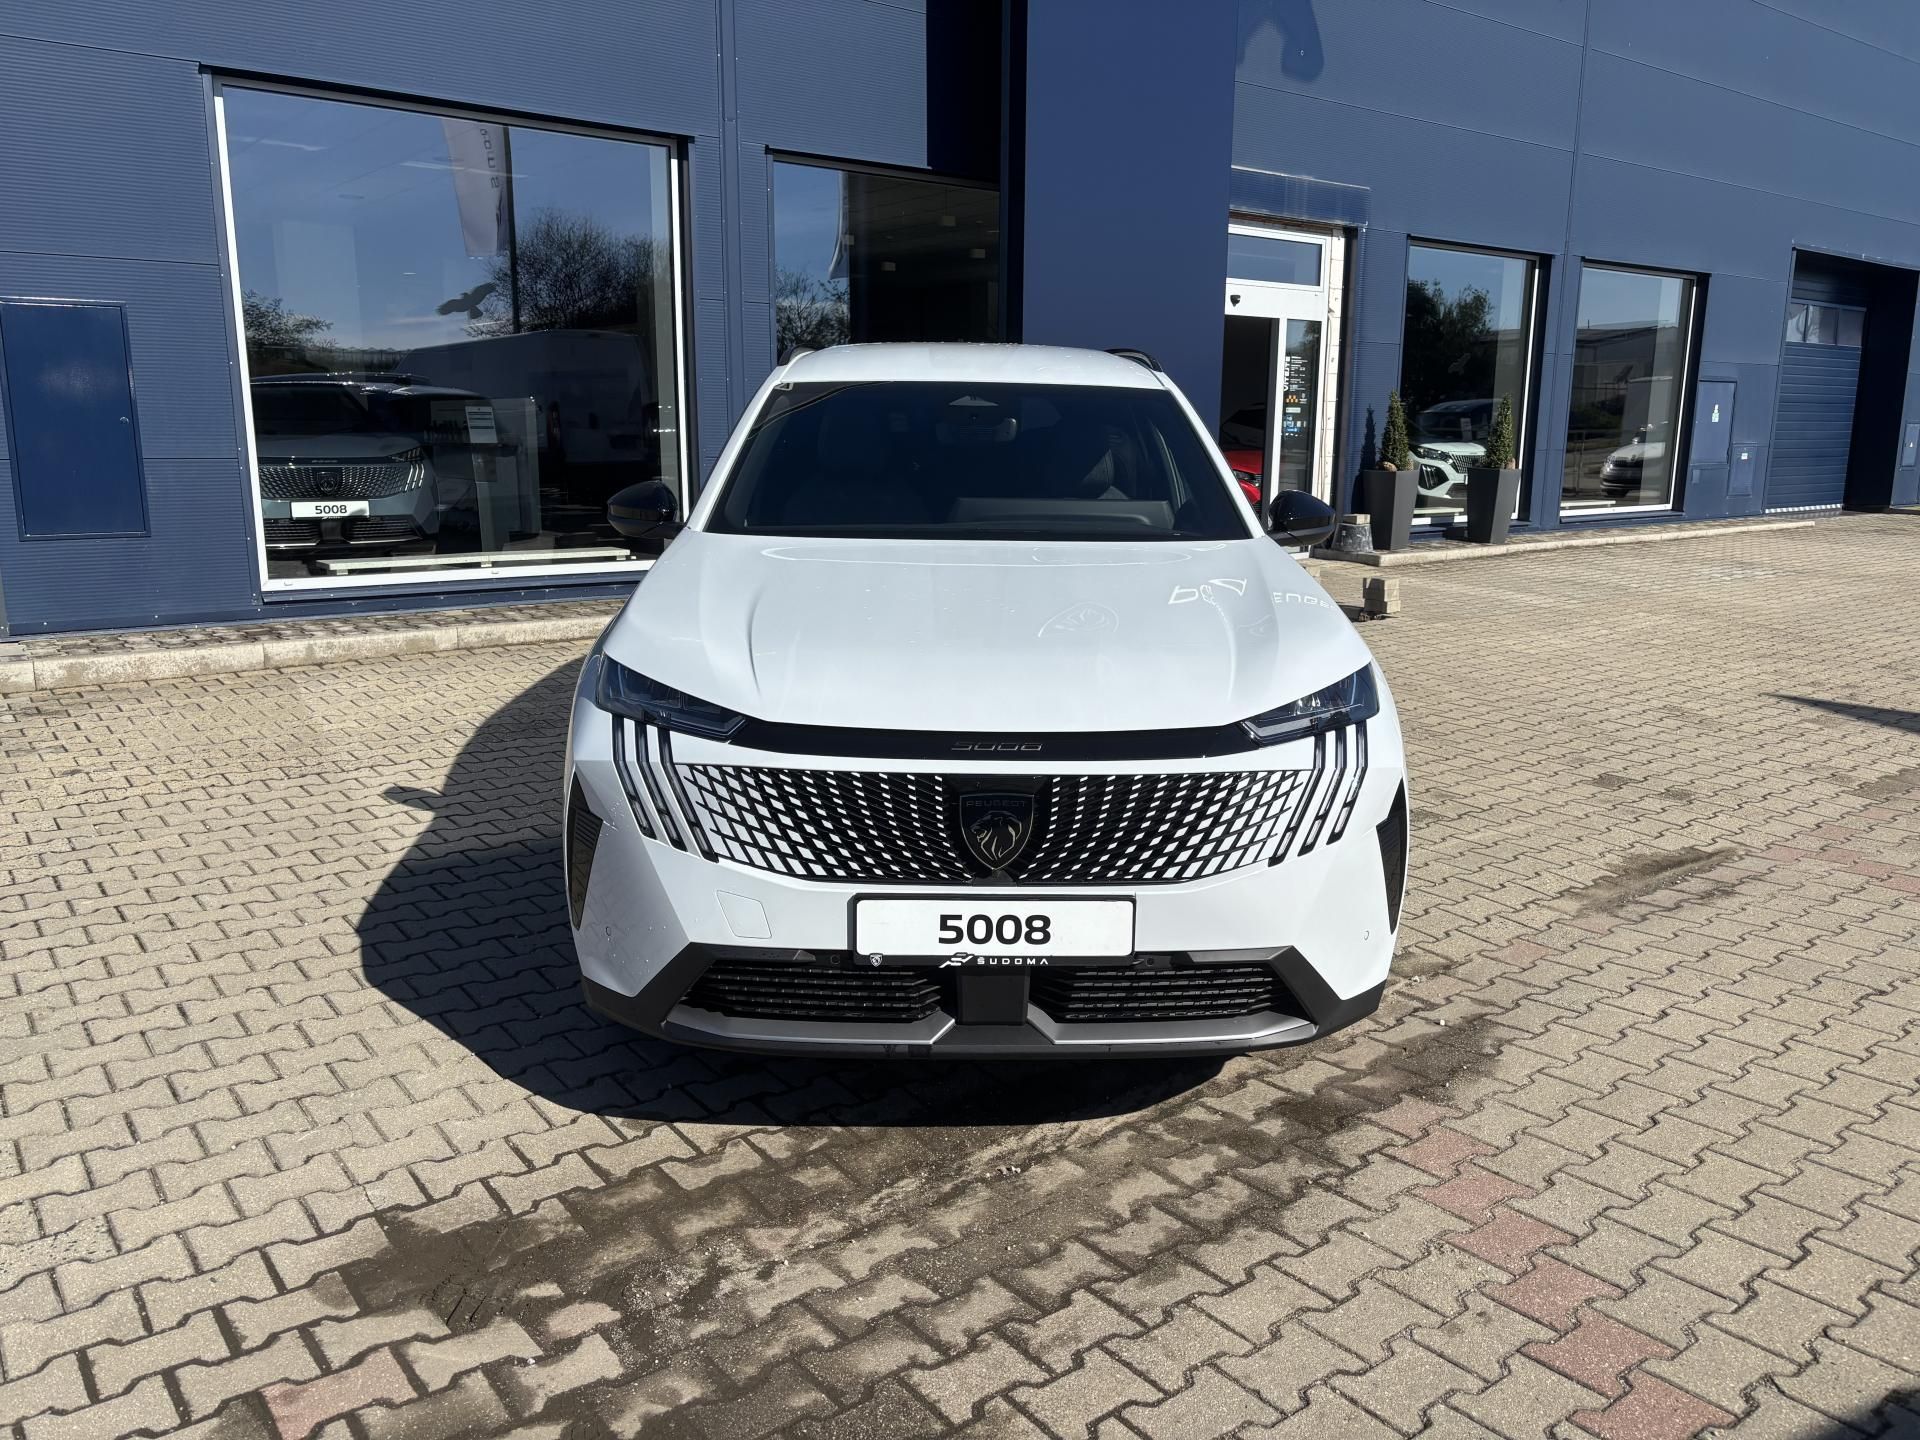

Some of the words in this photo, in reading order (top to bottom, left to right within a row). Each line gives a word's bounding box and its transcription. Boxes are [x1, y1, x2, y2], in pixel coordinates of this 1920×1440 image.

[315, 504, 347, 514] 5008
[966, 800, 1025, 808] PEUGEOT
[938, 914, 1051, 945] 5008
